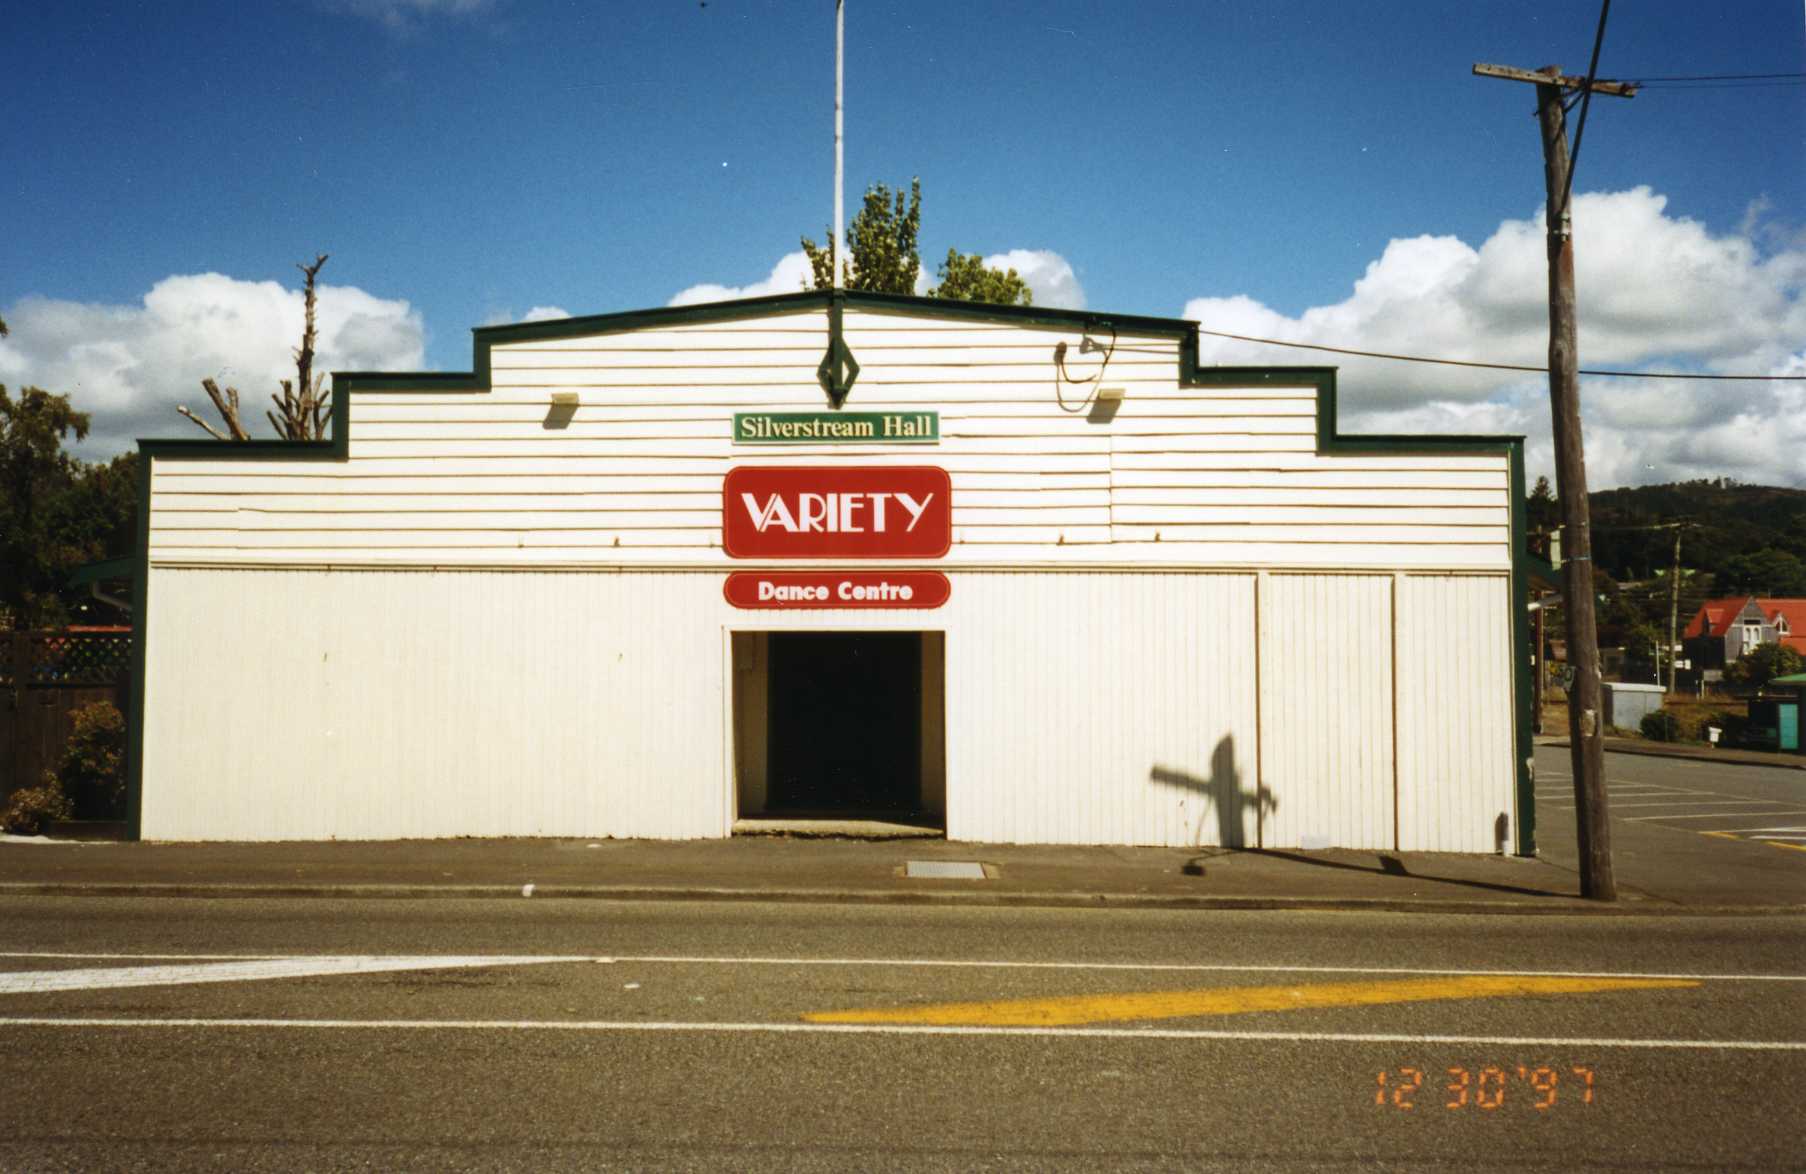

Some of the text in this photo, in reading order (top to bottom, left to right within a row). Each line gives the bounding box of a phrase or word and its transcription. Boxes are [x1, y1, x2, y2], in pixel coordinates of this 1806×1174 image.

[741, 416, 931, 437] Silverstream Hall
[741, 493, 934, 532] VARIETY
[758, 581, 913, 601] Dance Centre
